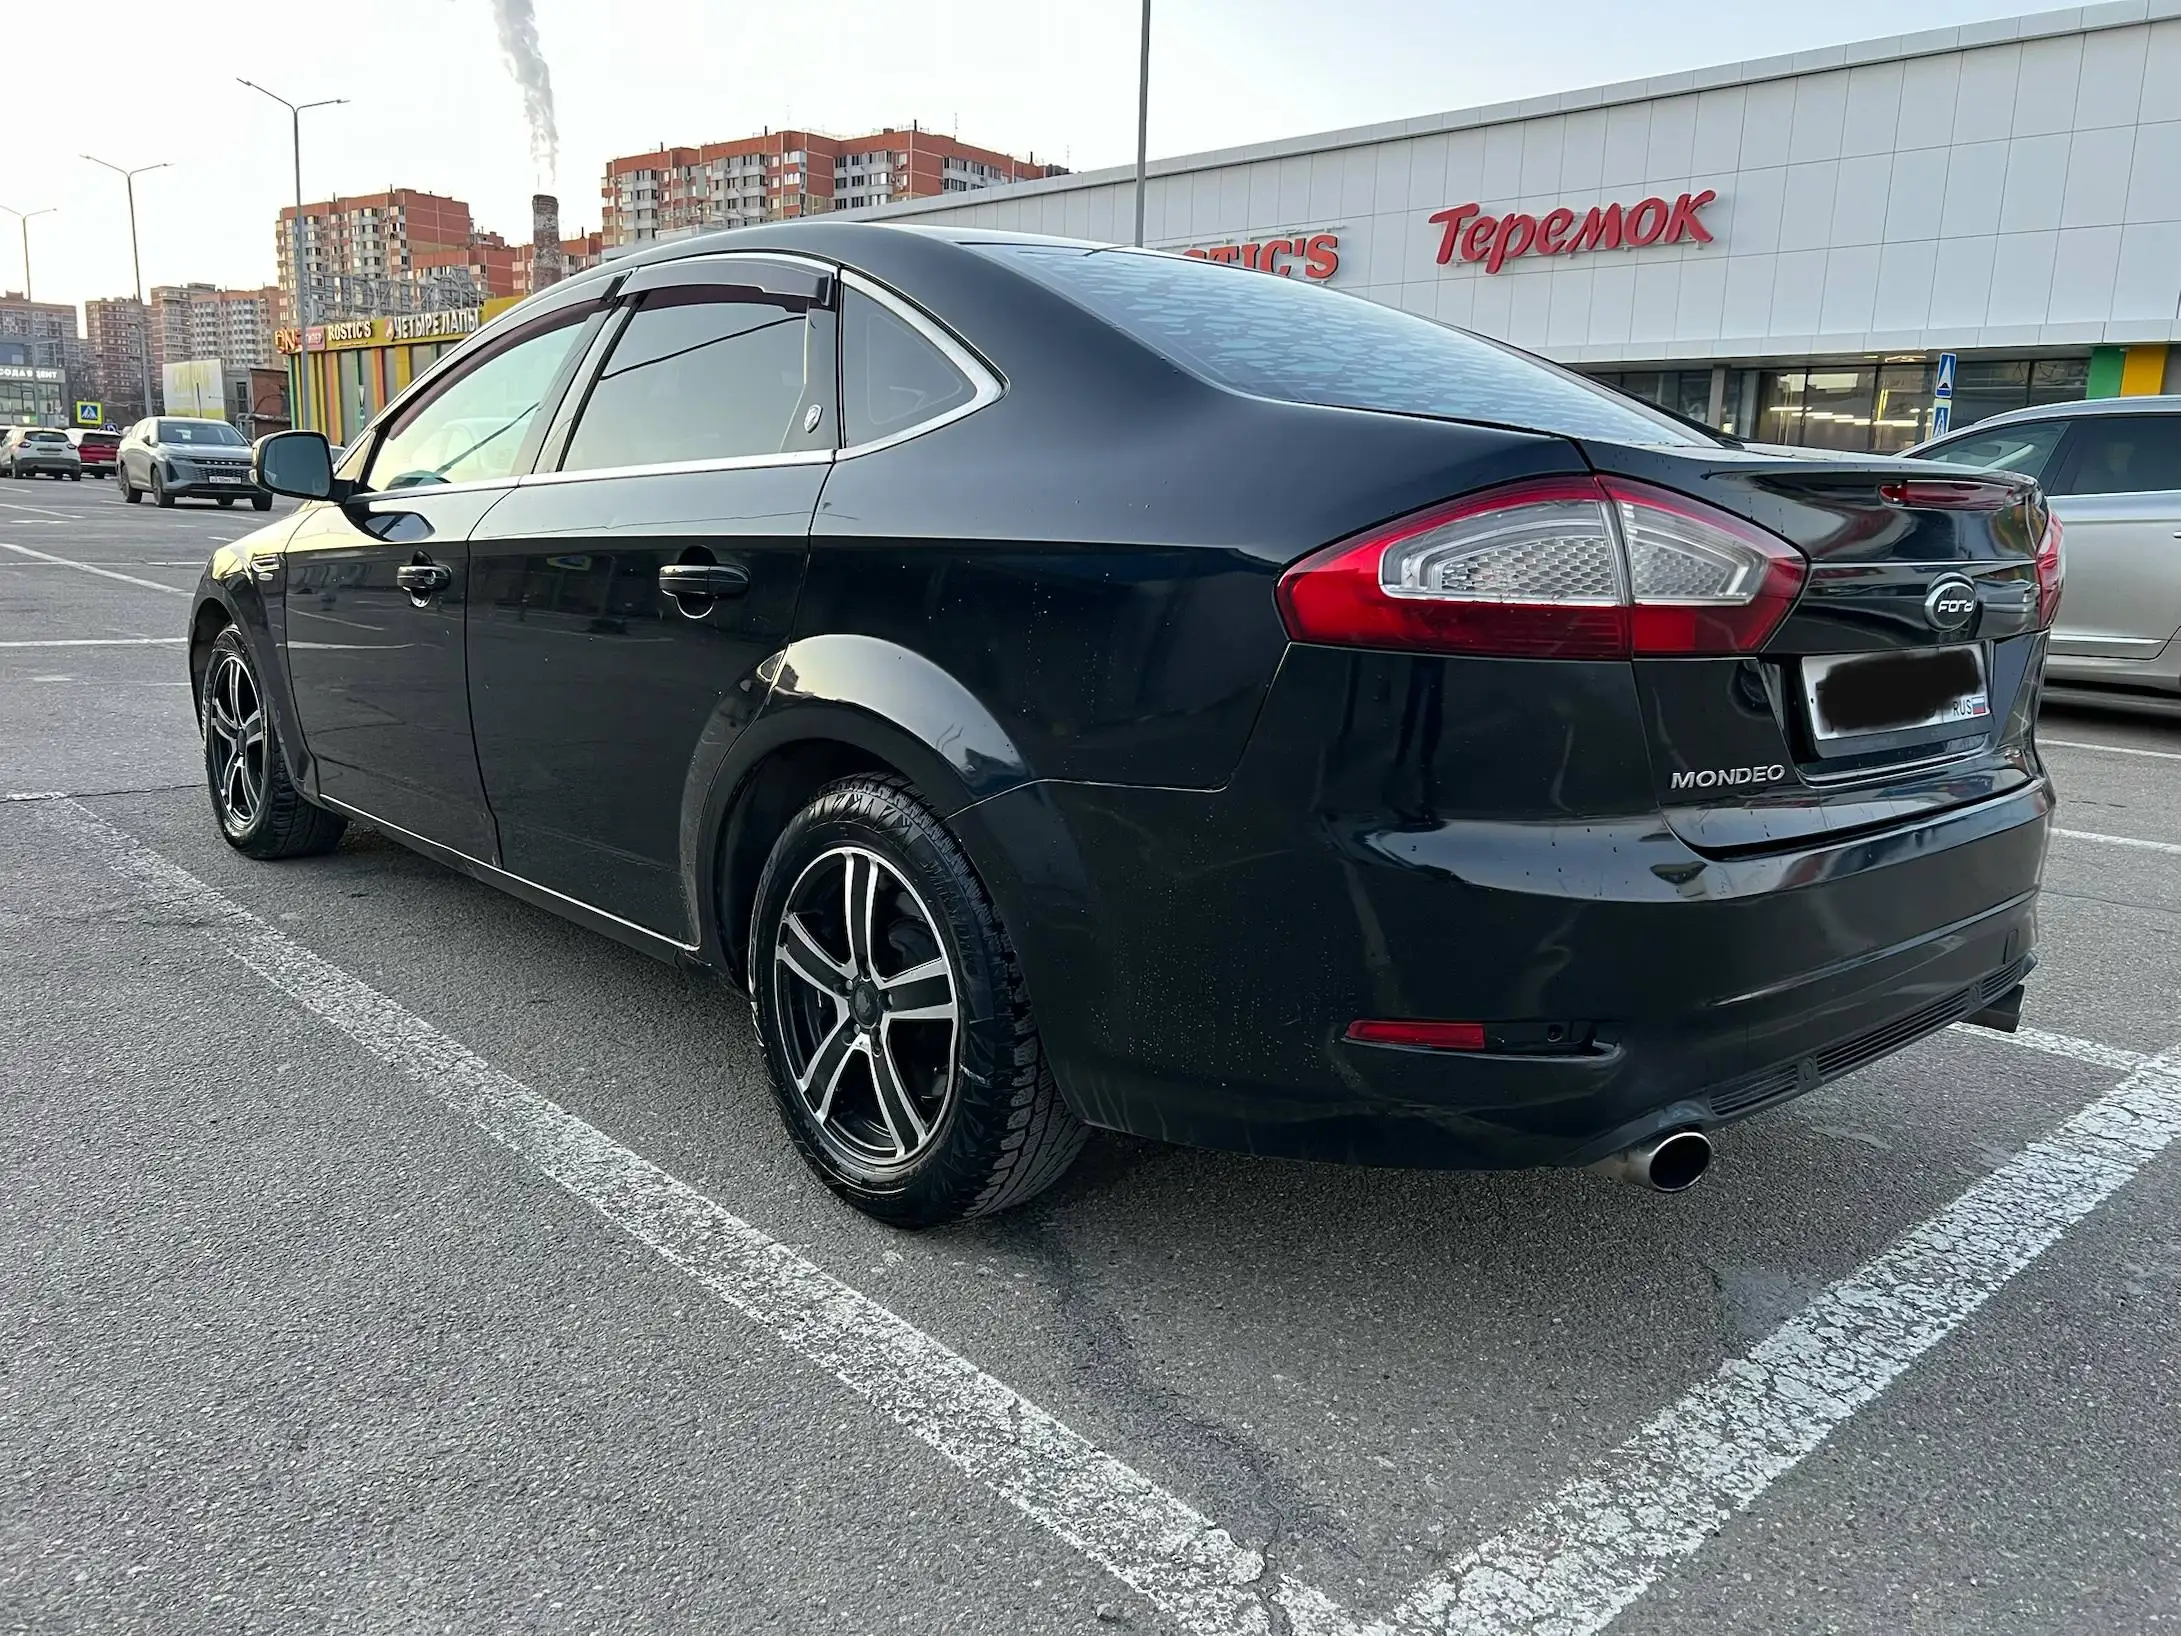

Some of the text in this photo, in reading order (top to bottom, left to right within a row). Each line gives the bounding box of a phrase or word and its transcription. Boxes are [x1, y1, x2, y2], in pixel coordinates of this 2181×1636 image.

[1428, 189, 1717, 275] Теремок
[327, 320, 372, 341] ROSTIC'S
[393, 307, 481, 340] ЧЕТЫРЕ ЛАПЫ
[1952, 700, 1973, 717] RUS
[1670, 764, 1786, 789] MONDEO
